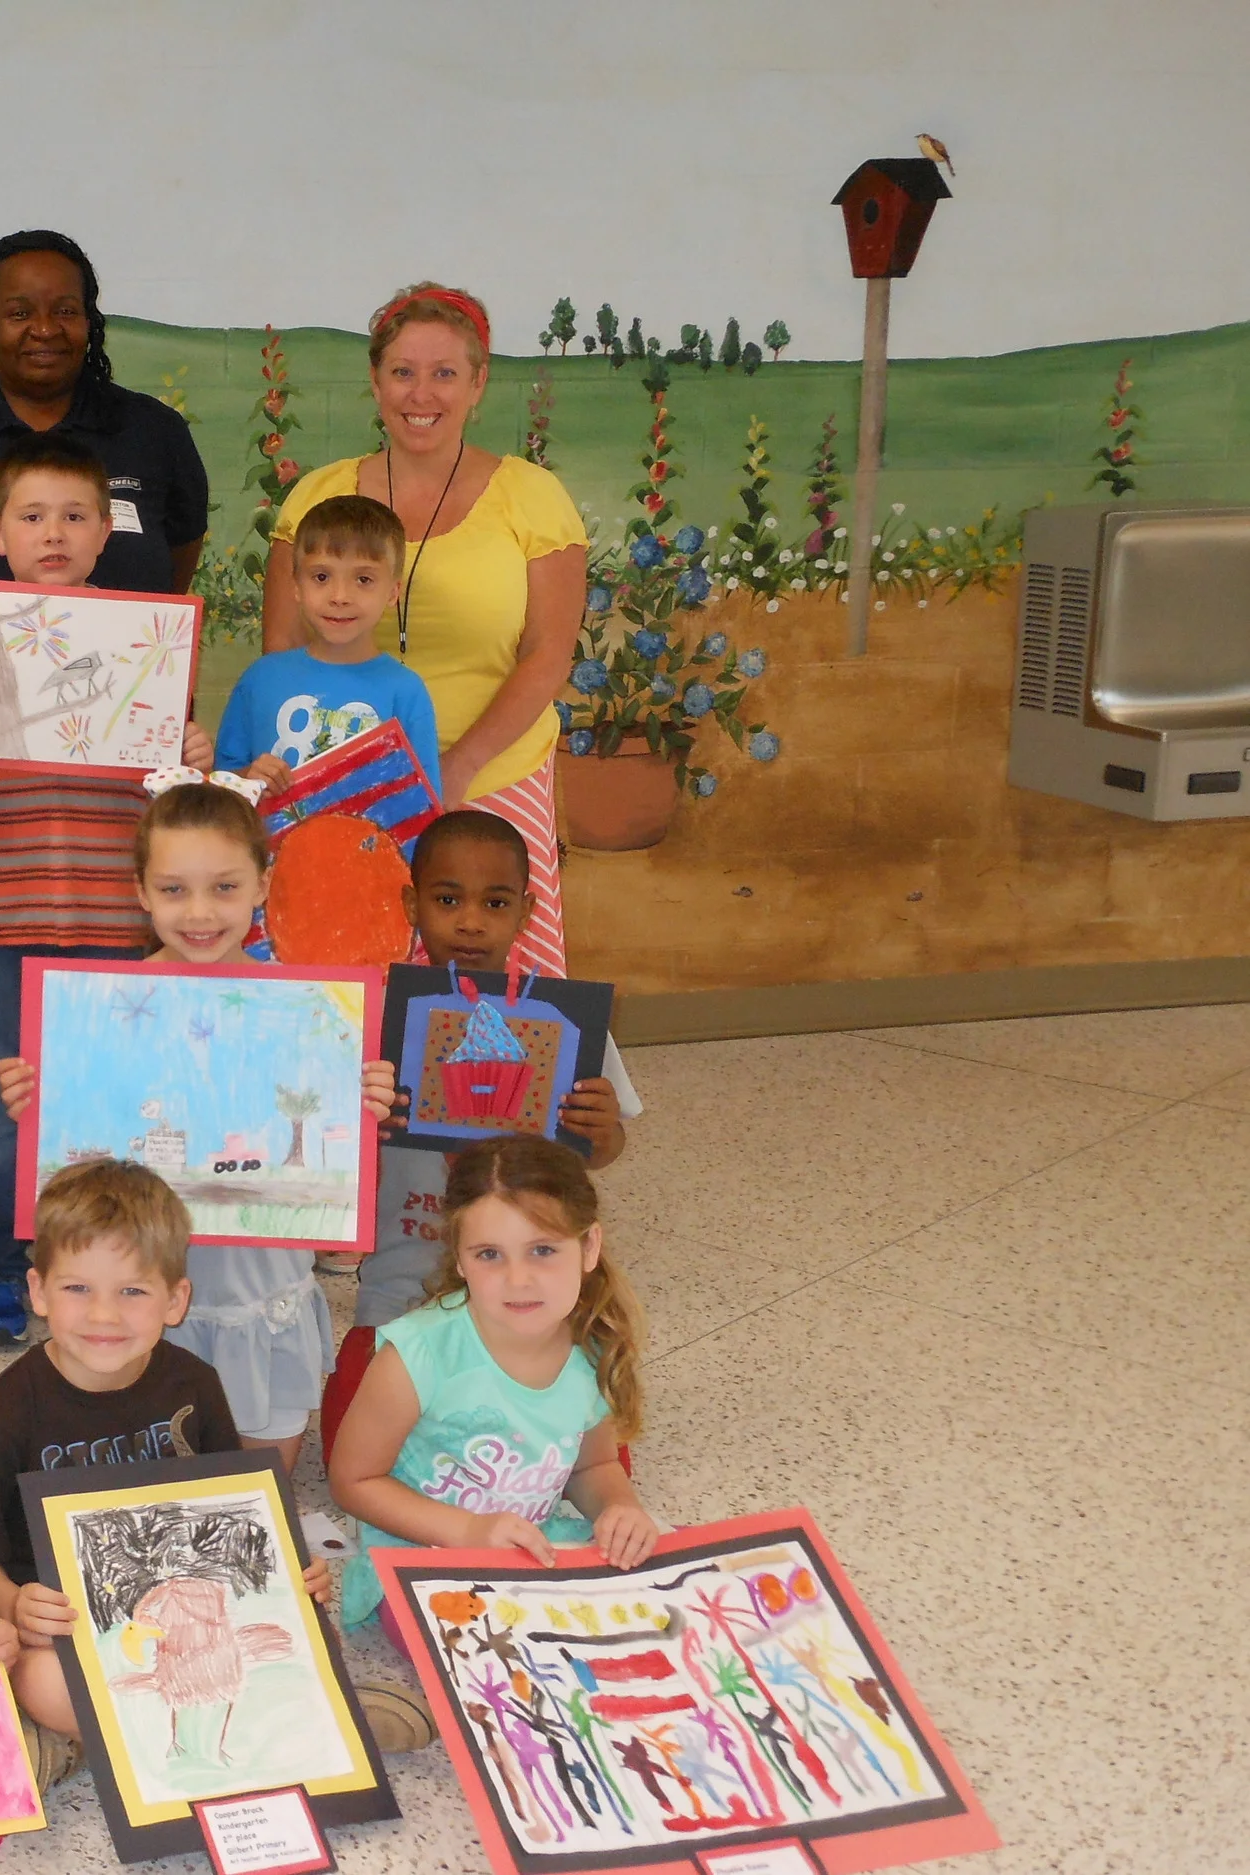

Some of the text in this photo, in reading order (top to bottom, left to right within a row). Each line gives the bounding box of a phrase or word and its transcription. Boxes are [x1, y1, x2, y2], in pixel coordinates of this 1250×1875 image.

[403, 1191, 440, 1214] PR
[462, 1438, 572, 1494] Siste
[217, 1818, 269, 1831] Kindergarten
[236, 1833, 257, 1843] place
[256, 1841, 286, 1851] Primary
